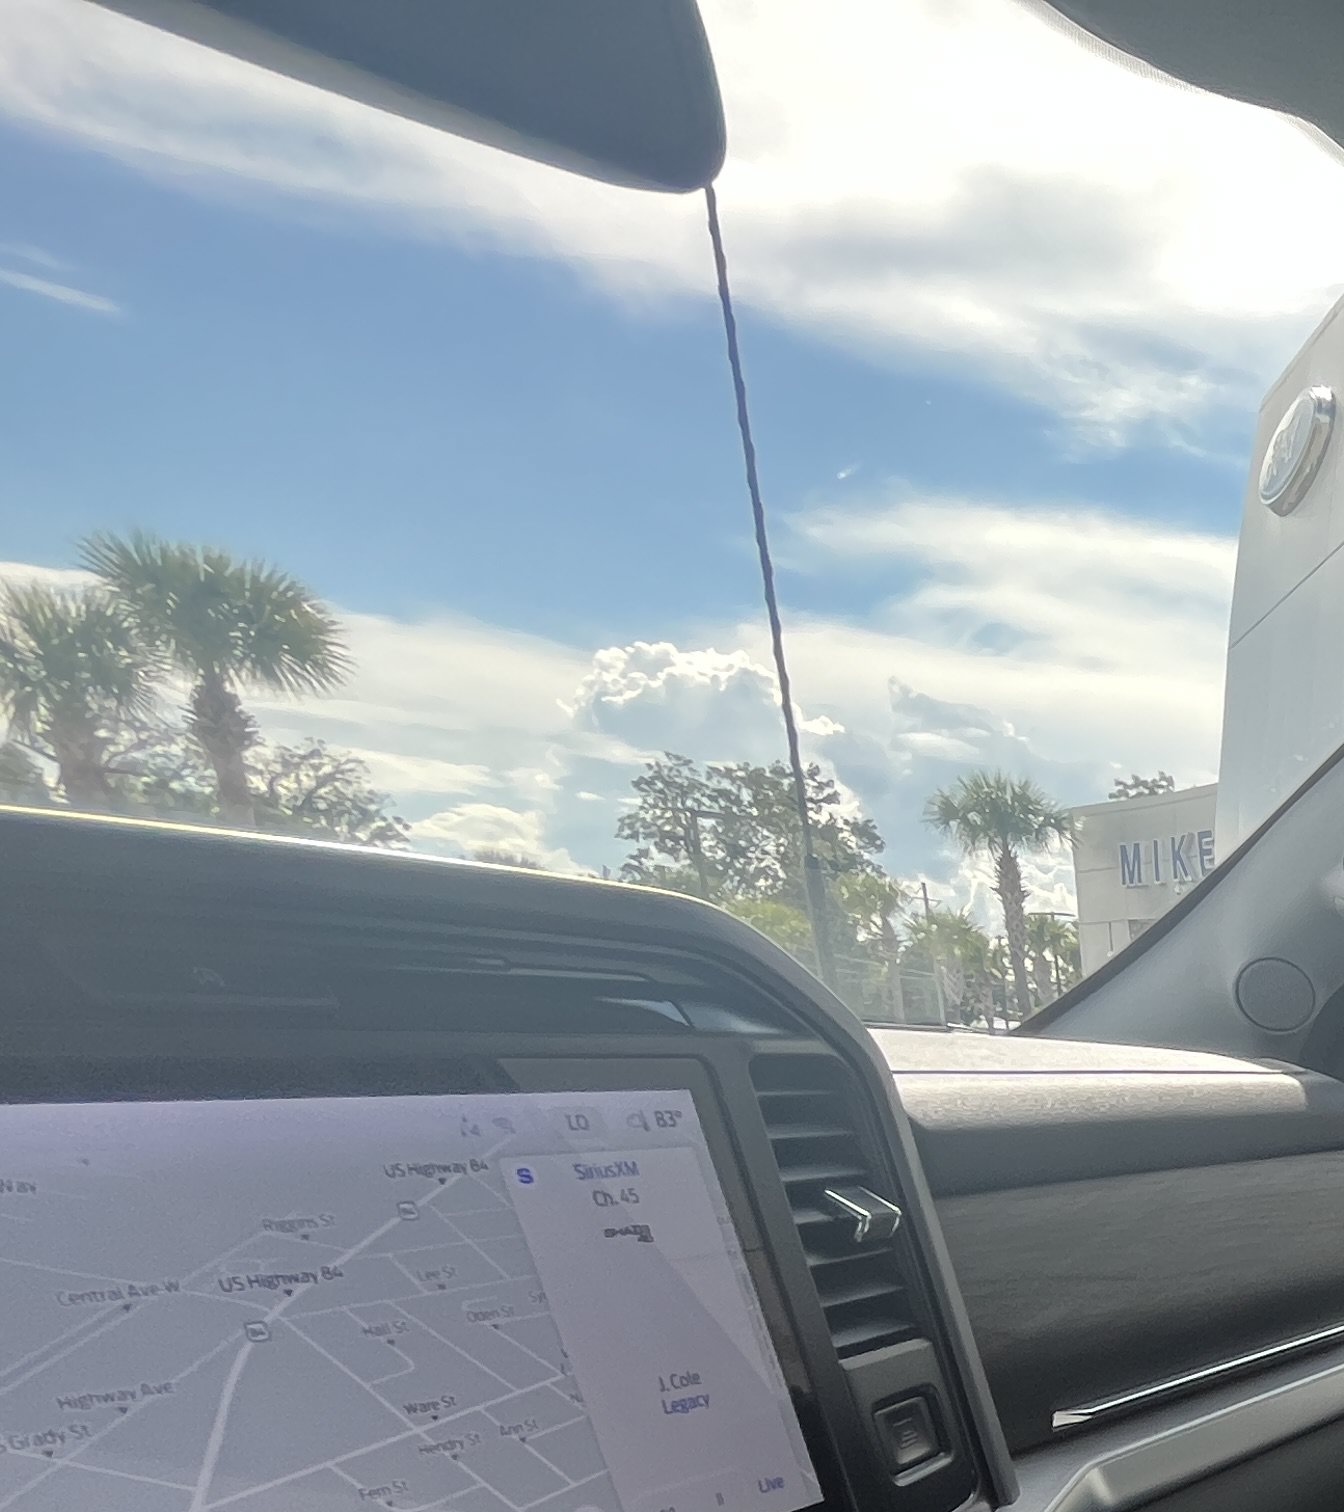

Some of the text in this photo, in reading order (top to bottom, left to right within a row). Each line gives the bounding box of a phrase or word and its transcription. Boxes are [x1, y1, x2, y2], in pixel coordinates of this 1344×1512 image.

[1119, 829, 1215, 886] MIKE
[564, 1113, 591, 1131] LO
[384, 1162, 406, 1179] US
[407, 1160, 470, 1178] Highway
[572, 1160, 641, 1181] SiriusXM
[592, 1187, 640, 1208] Ch. 45
[319, 1213, 336, 1228] St
[217, 1265, 345, 1294] US Highway 84
[441, 1264, 458, 1279] St
[55, 1279, 180, 1307] Central Ave W
[392, 1318, 410, 1334] St
[56, 1381, 175, 1411] Highway Ave
[402, 1394, 457, 1416] Ware St
[661, 1393, 710, 1415] Legacy
[8, 1428, 66, 1451] Grady
[67, 1423, 93, 1441] St
[757, 1473, 785, 1495] Live
